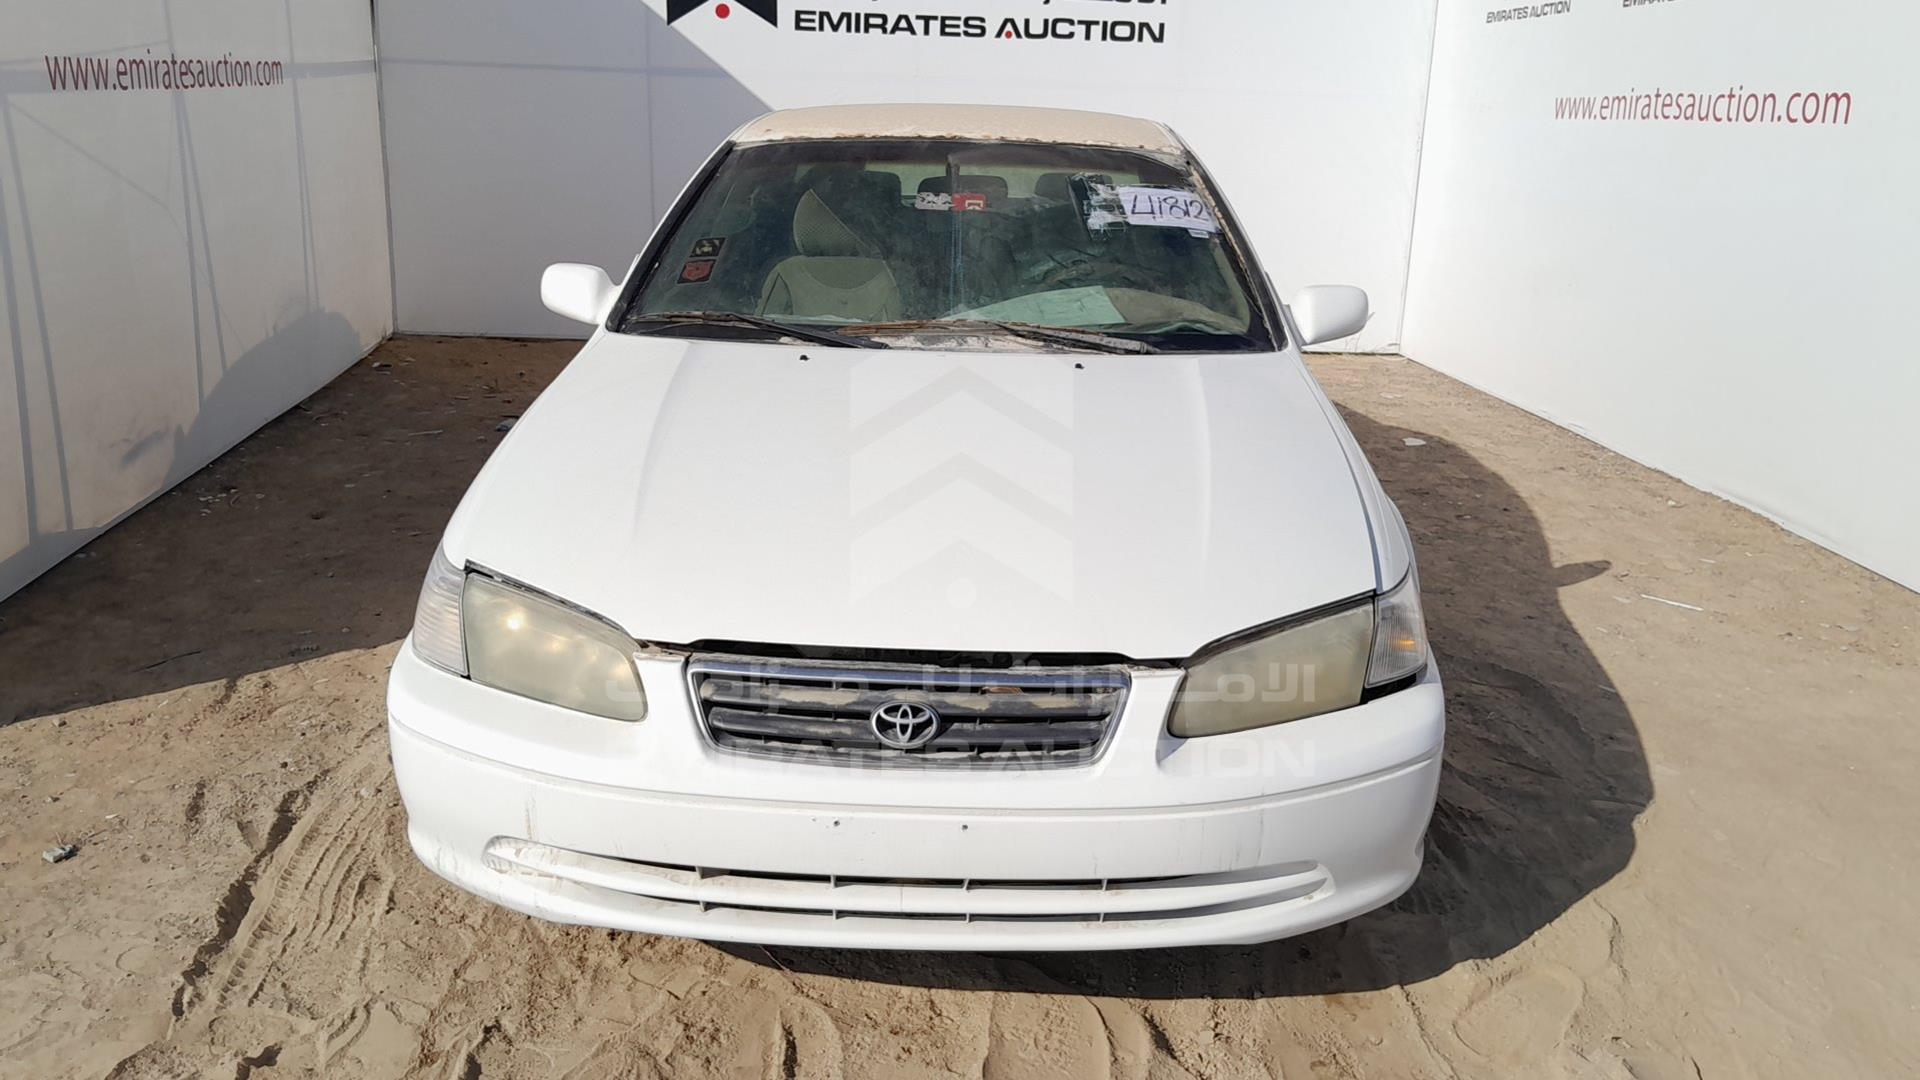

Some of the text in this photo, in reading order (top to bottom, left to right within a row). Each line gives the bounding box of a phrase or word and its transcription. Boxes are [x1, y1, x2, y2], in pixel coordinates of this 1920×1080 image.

[794, 9, 1165, 43] EMIRATES AUCTION
[1486, 0, 1572, 23] EMIRATES AUCTION
[1554, 85, 1852, 125] www.emiratesauction.com
